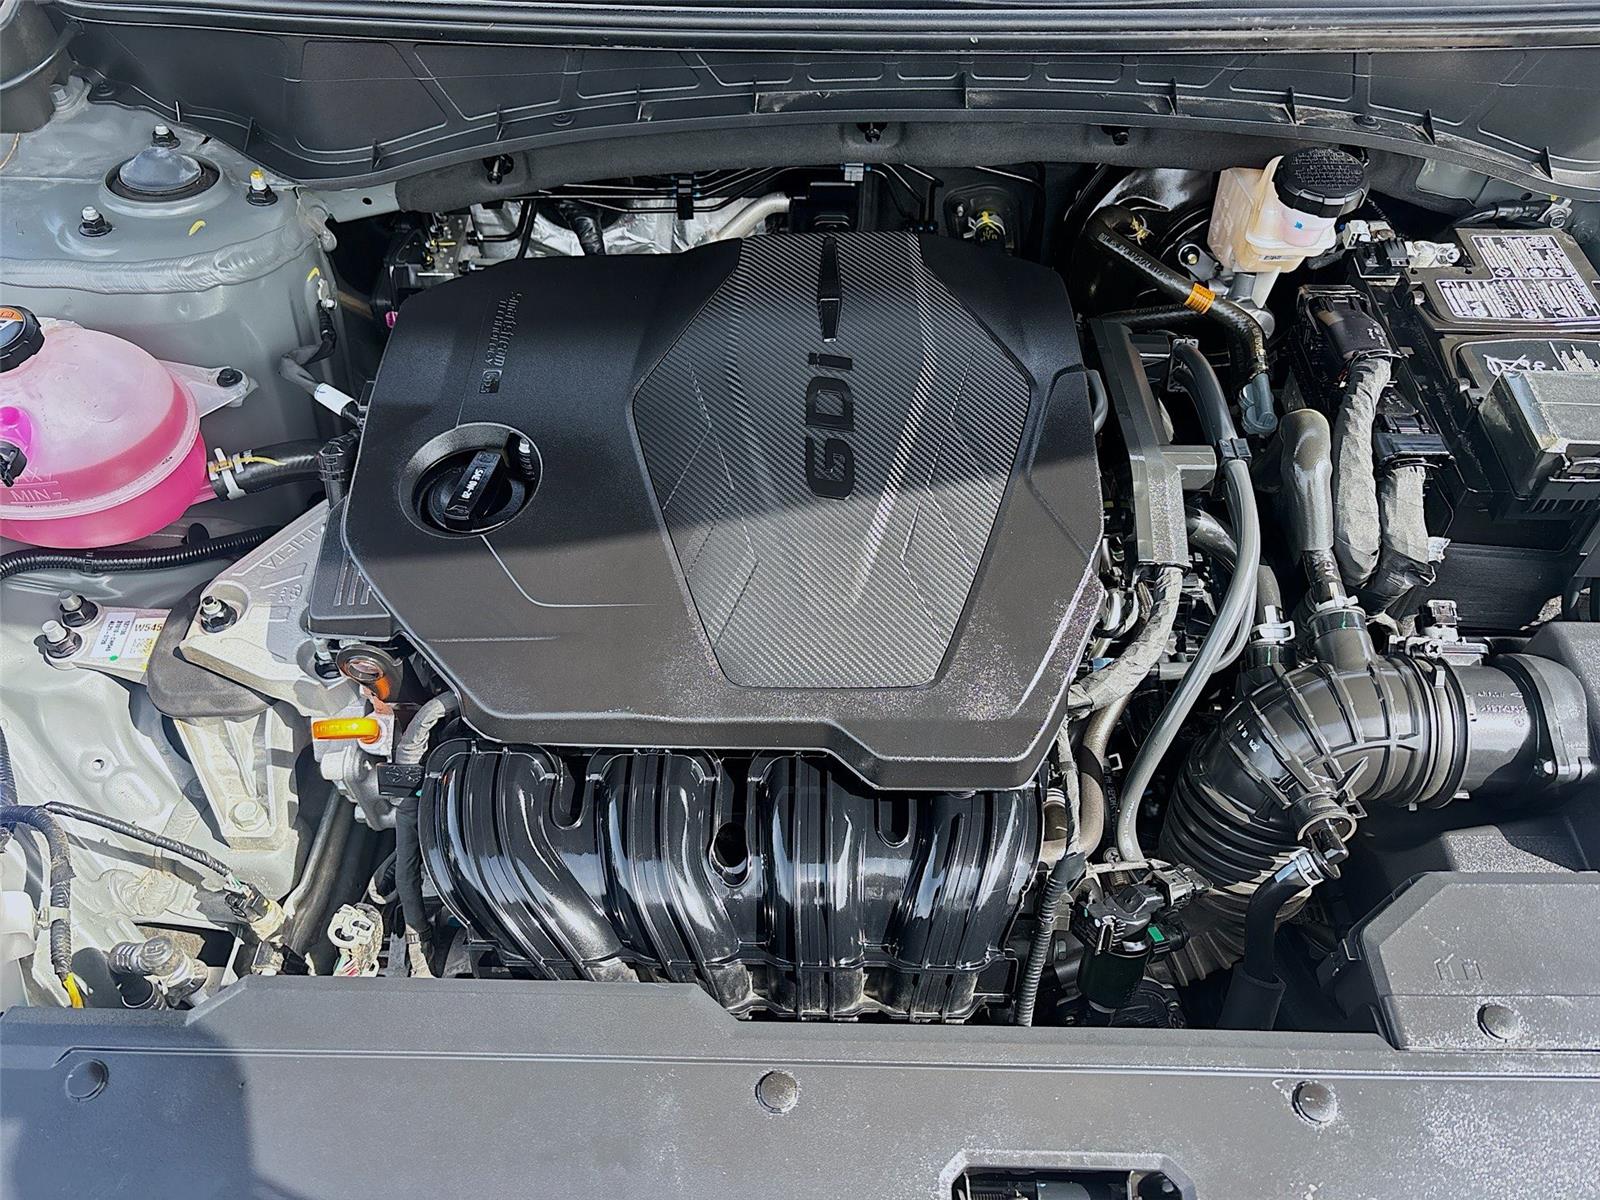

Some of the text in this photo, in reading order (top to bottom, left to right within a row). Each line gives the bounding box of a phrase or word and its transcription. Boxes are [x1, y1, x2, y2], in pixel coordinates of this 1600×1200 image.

[804, 352, 855, 501] GDi
[10, 488, 51, 502] MIN
[261, 527, 319, 570] THETA
